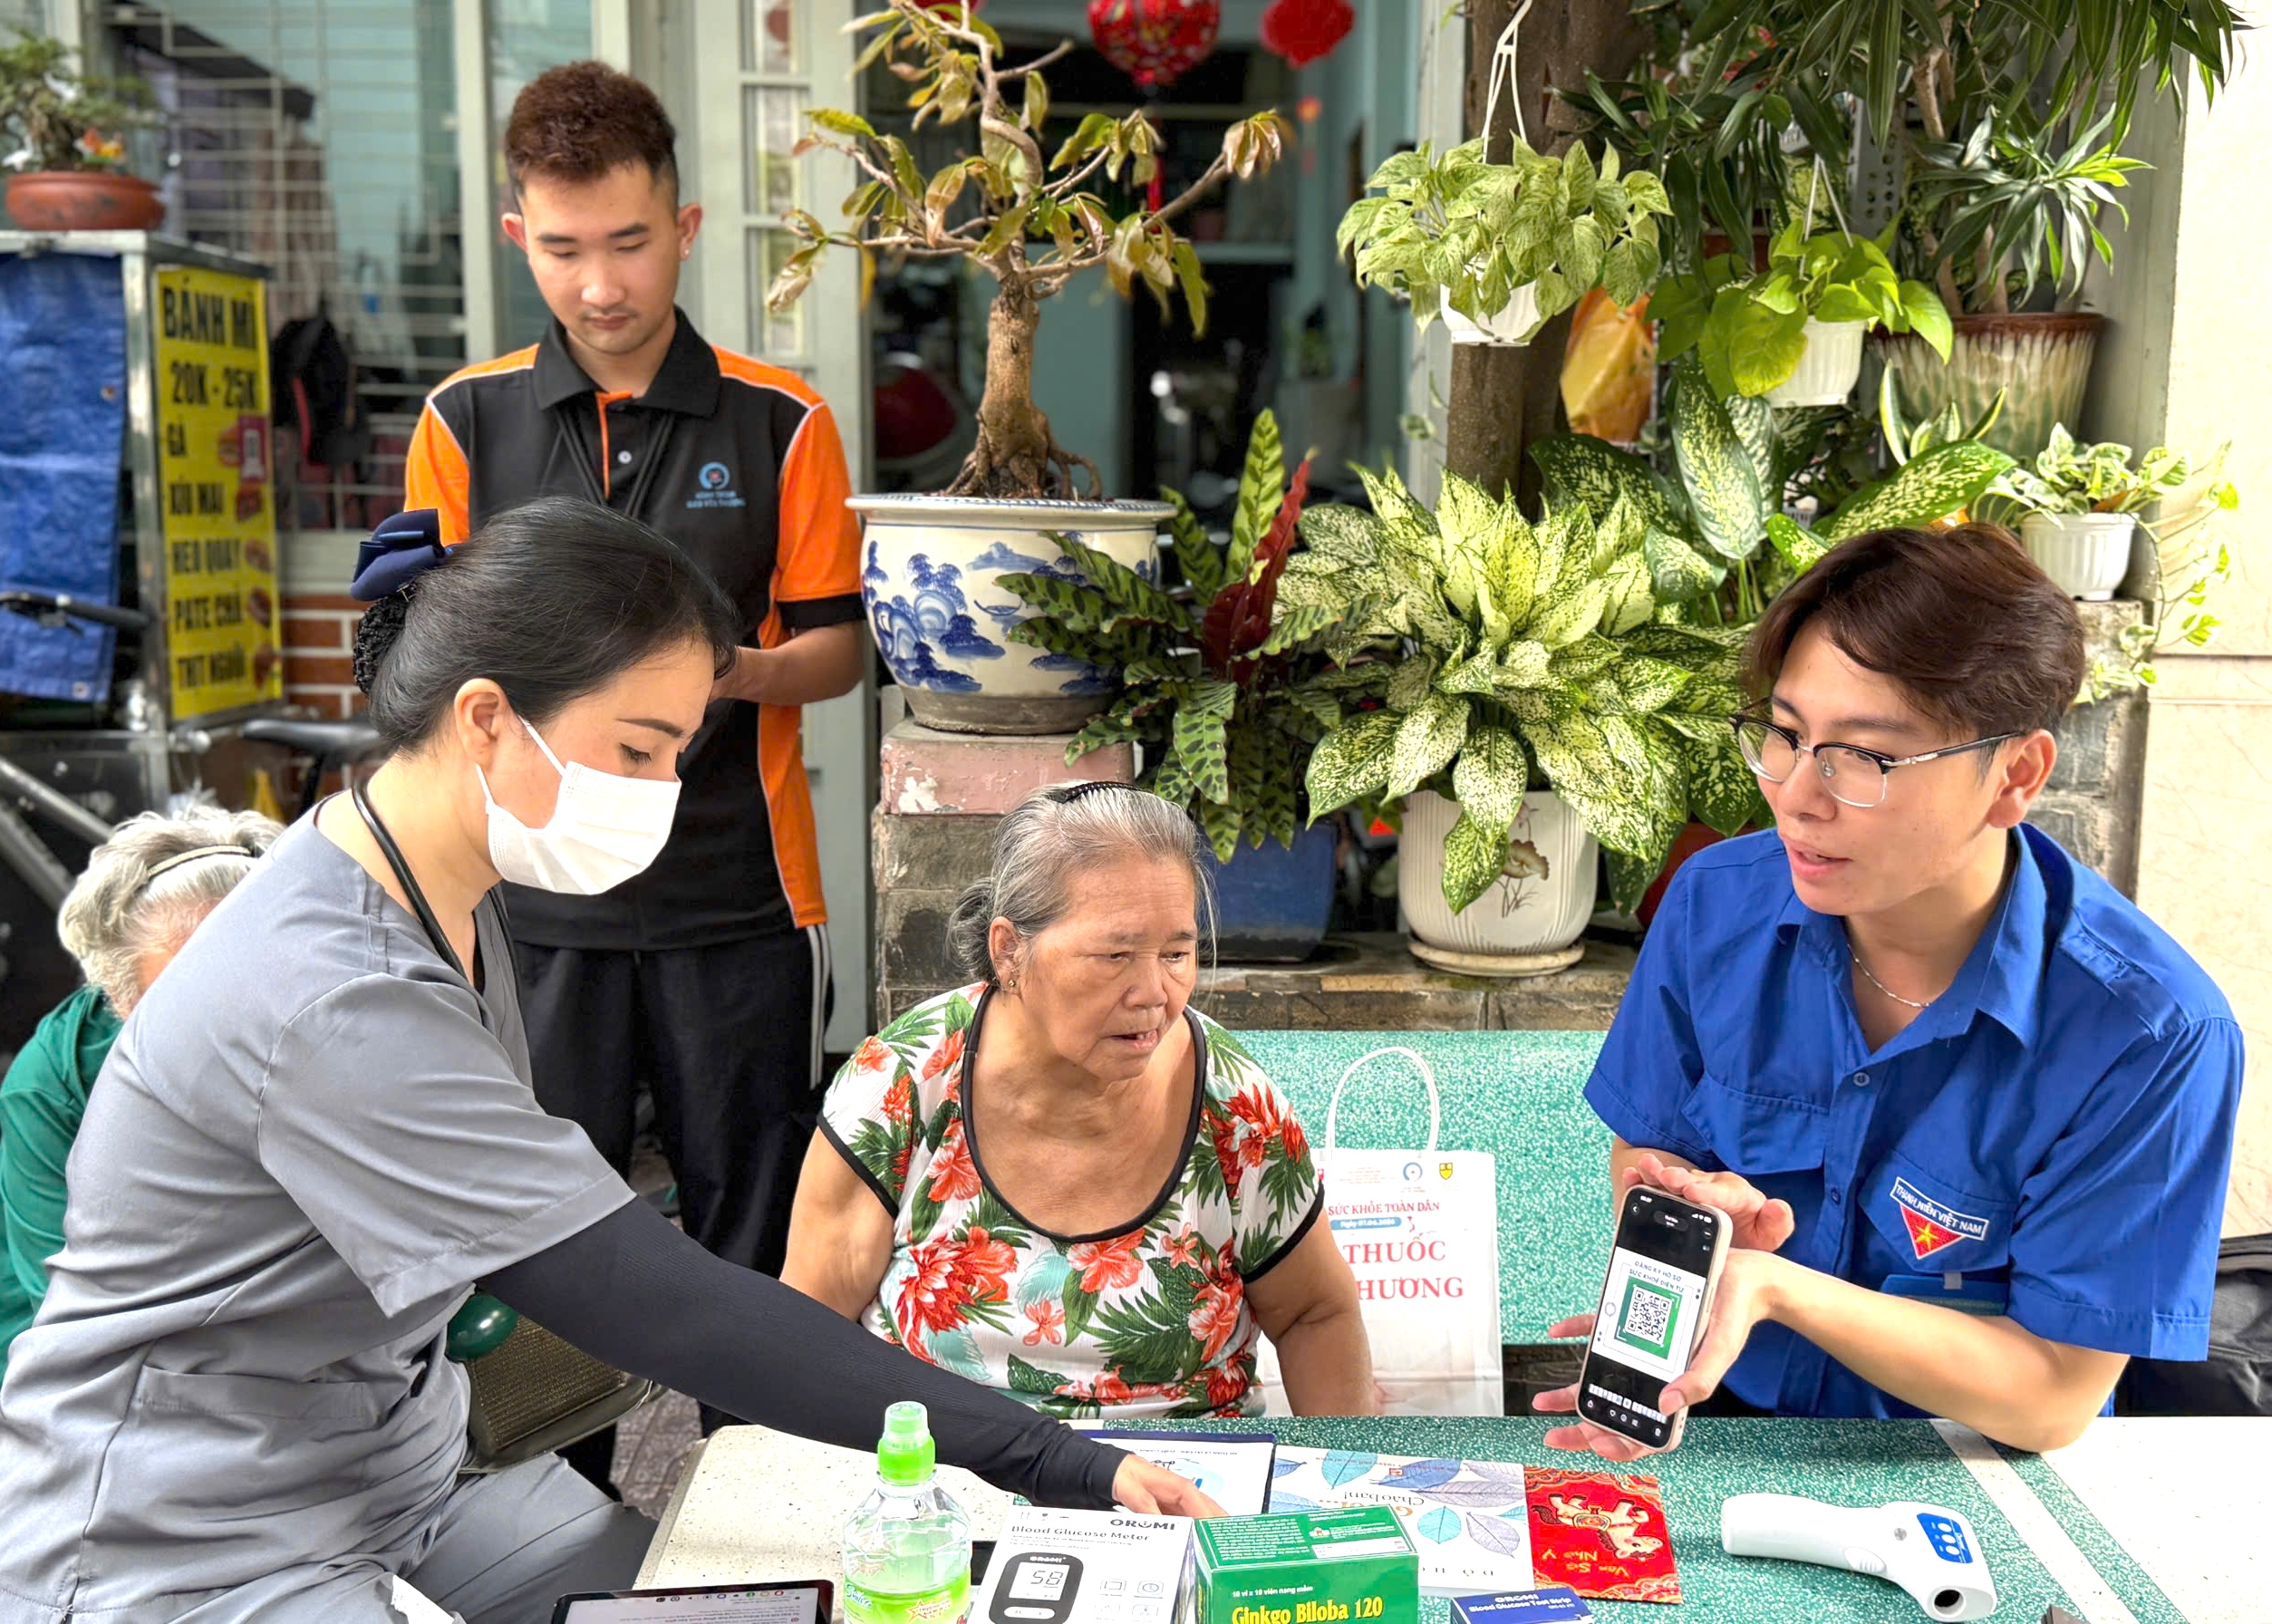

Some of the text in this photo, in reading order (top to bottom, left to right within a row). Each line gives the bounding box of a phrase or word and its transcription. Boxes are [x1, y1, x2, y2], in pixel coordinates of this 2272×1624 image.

[162, 276, 226, 345] BÁNH
[170, 359, 209, 406] 20K
[223, 366, 258, 411] 25K
[1328, 1203, 1350, 1215] SỨC
[1384, 1200, 1415, 1213] TOÀN
[1938, 1213, 1958, 1228] VIỆT
[1958, 1221, 1983, 1235] NAM
[1342, 1232, 1446, 1264] THUỐC
[1010, 1525, 1151, 1541] Blood Glucose Meter
[1030, 1570, 1064, 1585] 58
[1232, 1597, 1384, 1624] Ginkgo Biloba 120
[1468, 1604, 1495, 1613] Blood
[1495, 1600, 1531, 1610] Glucose
[1551, 1596, 1572, 1605] Strip
